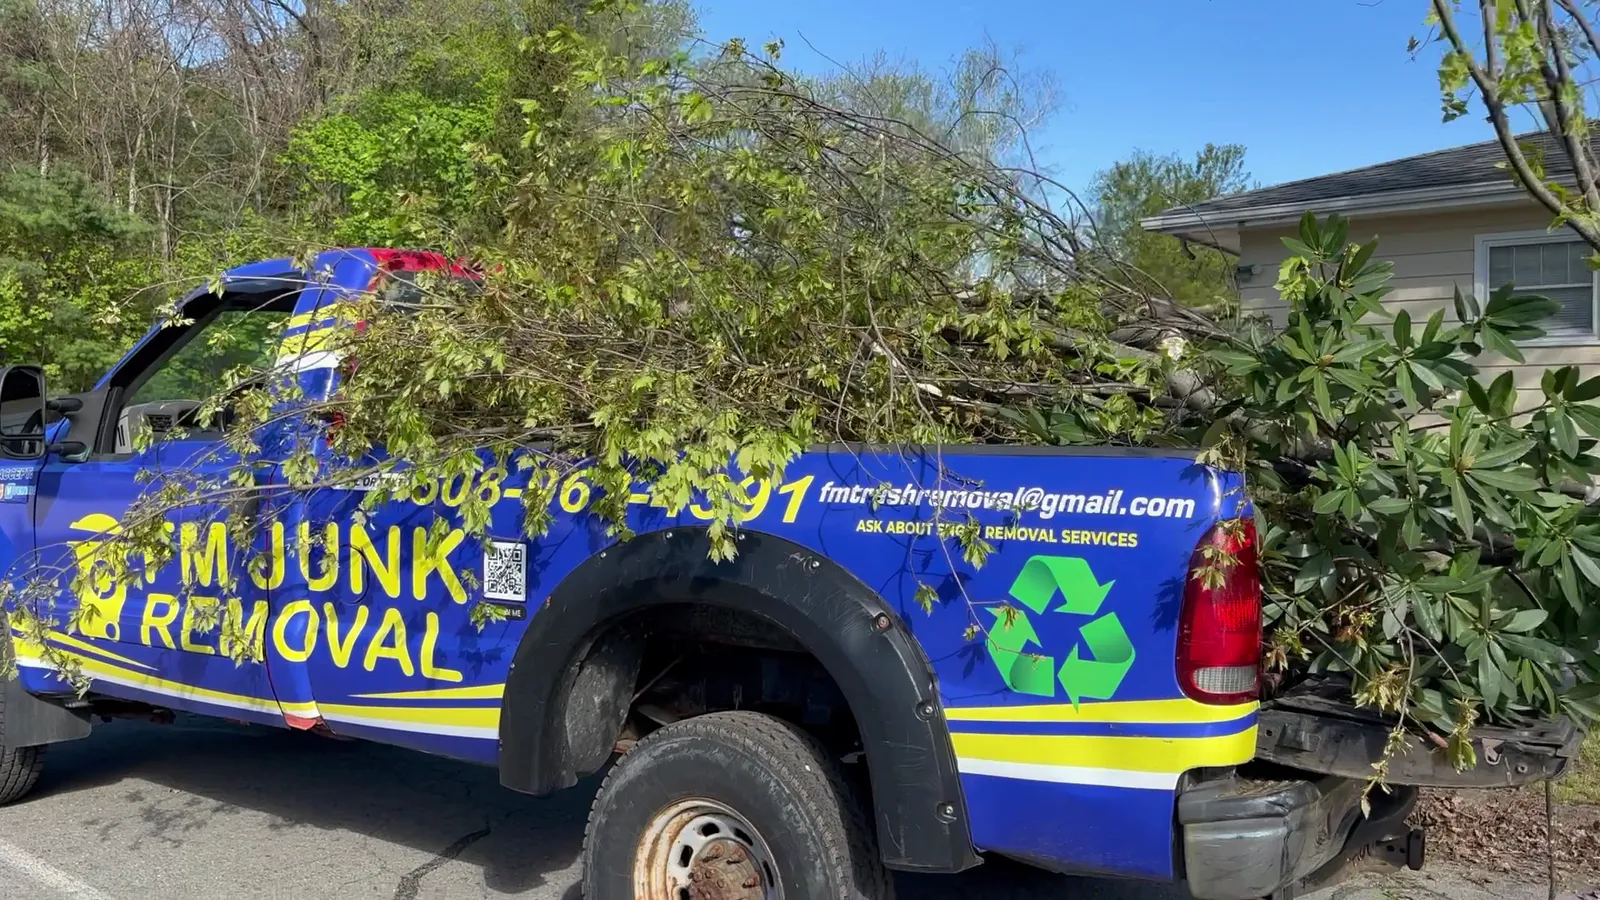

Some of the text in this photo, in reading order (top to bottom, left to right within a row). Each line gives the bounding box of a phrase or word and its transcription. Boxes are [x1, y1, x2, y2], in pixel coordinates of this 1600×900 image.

[363, 477, 376, 487] OR
[856, 519, 1138, 548] ASK ABOUT SNO REMOVAL SERVICES
[248, 520, 468, 604] JUNK
[140, 593, 463, 683] REMOVAL
